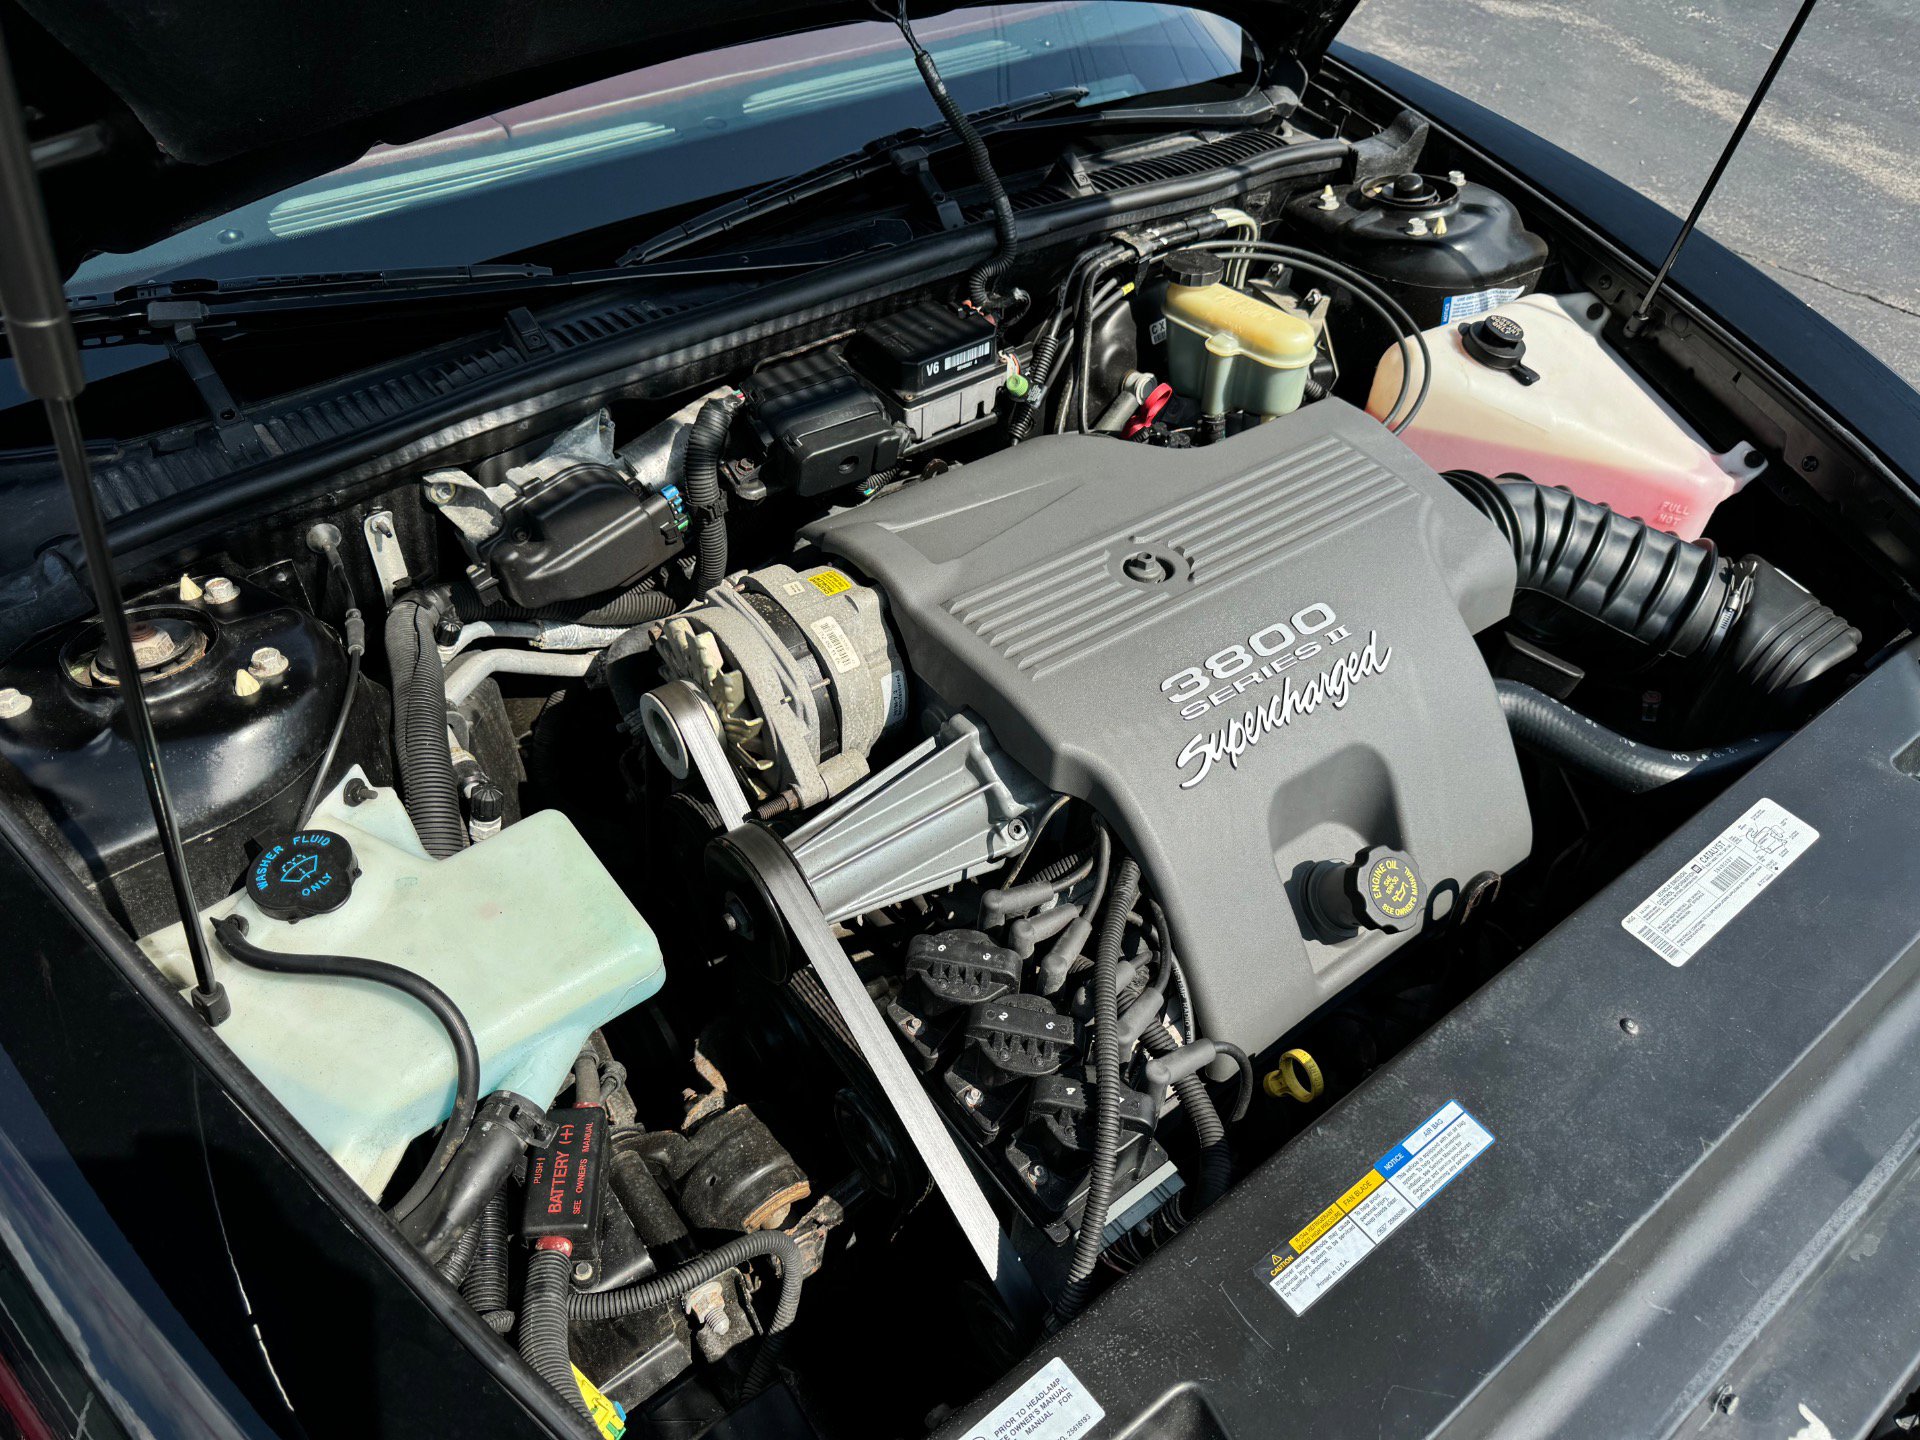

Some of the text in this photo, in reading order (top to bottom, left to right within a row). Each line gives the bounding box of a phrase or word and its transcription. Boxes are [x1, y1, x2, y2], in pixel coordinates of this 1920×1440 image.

[926, 361, 940, 377] V6
[1661, 501, 1690, 515] FULL
[1160, 602, 1336, 703] 3800
[1180, 625, 1352, 720] SERIES II
[1176, 630, 1391, 789] Supercharged
[256, 835, 330, 891] WASHER FLUID
[1699, 840, 1726, 864] CATALYST
[302, 873, 332, 896] ONLY
[1372, 863, 1386, 899] ENGINE
[1386, 860, 1399, 870] OIL
[1382, 903, 1394, 915] SEE
[1405, 866, 1418, 896] MANUAL
[938, 944, 991, 960] 6 3
[999, 1012, 1008, 1021] 2
[1422, 1118, 1444, 1138] AIR BAG
[533, 1161, 544, 1184] PUSH
[572, 1122, 594, 1214] SEE OWNER'S MANUAL
[1383, 1152, 1405, 1171] NOTICE
[548, 1151, 570, 1213] BATTERY
[1343, 1180, 1372, 1207] FAN BLADE
[1359, 1202, 1371, 1213] help
[1359, 1205, 1378, 1222] personal
[1364, 1216, 1376, 1227] keep
[1373, 1205, 1388, 1218] hands
[1297, 1210, 1342, 1251] UNDER HIGH PRESSURE
[1307, 1208, 1334, 1233] REFRIGERANT
[1270, 1254, 1294, 1277] CAUTION
[1274, 1220, 1351, 1287] Improper service methods may cause
[1279, 1274, 1300, 1293] personal
[1310, 1249, 1328, 1265] System
[1338, 1224, 1356, 1241] serviced
[1284, 1290, 1292, 1298] by
[1290, 1275, 1309, 1293] qualified
[1316, 1273, 1333, 1289] Printed
[993, 1377, 1062, 1438] PRIOR TO HEADLAMP
[1009, 1407, 1041, 1437] OWNER'S
[1039, 1384, 1068, 1410] MANUAL
[1024, 1391, 1074, 1435] MANUAL FOR
